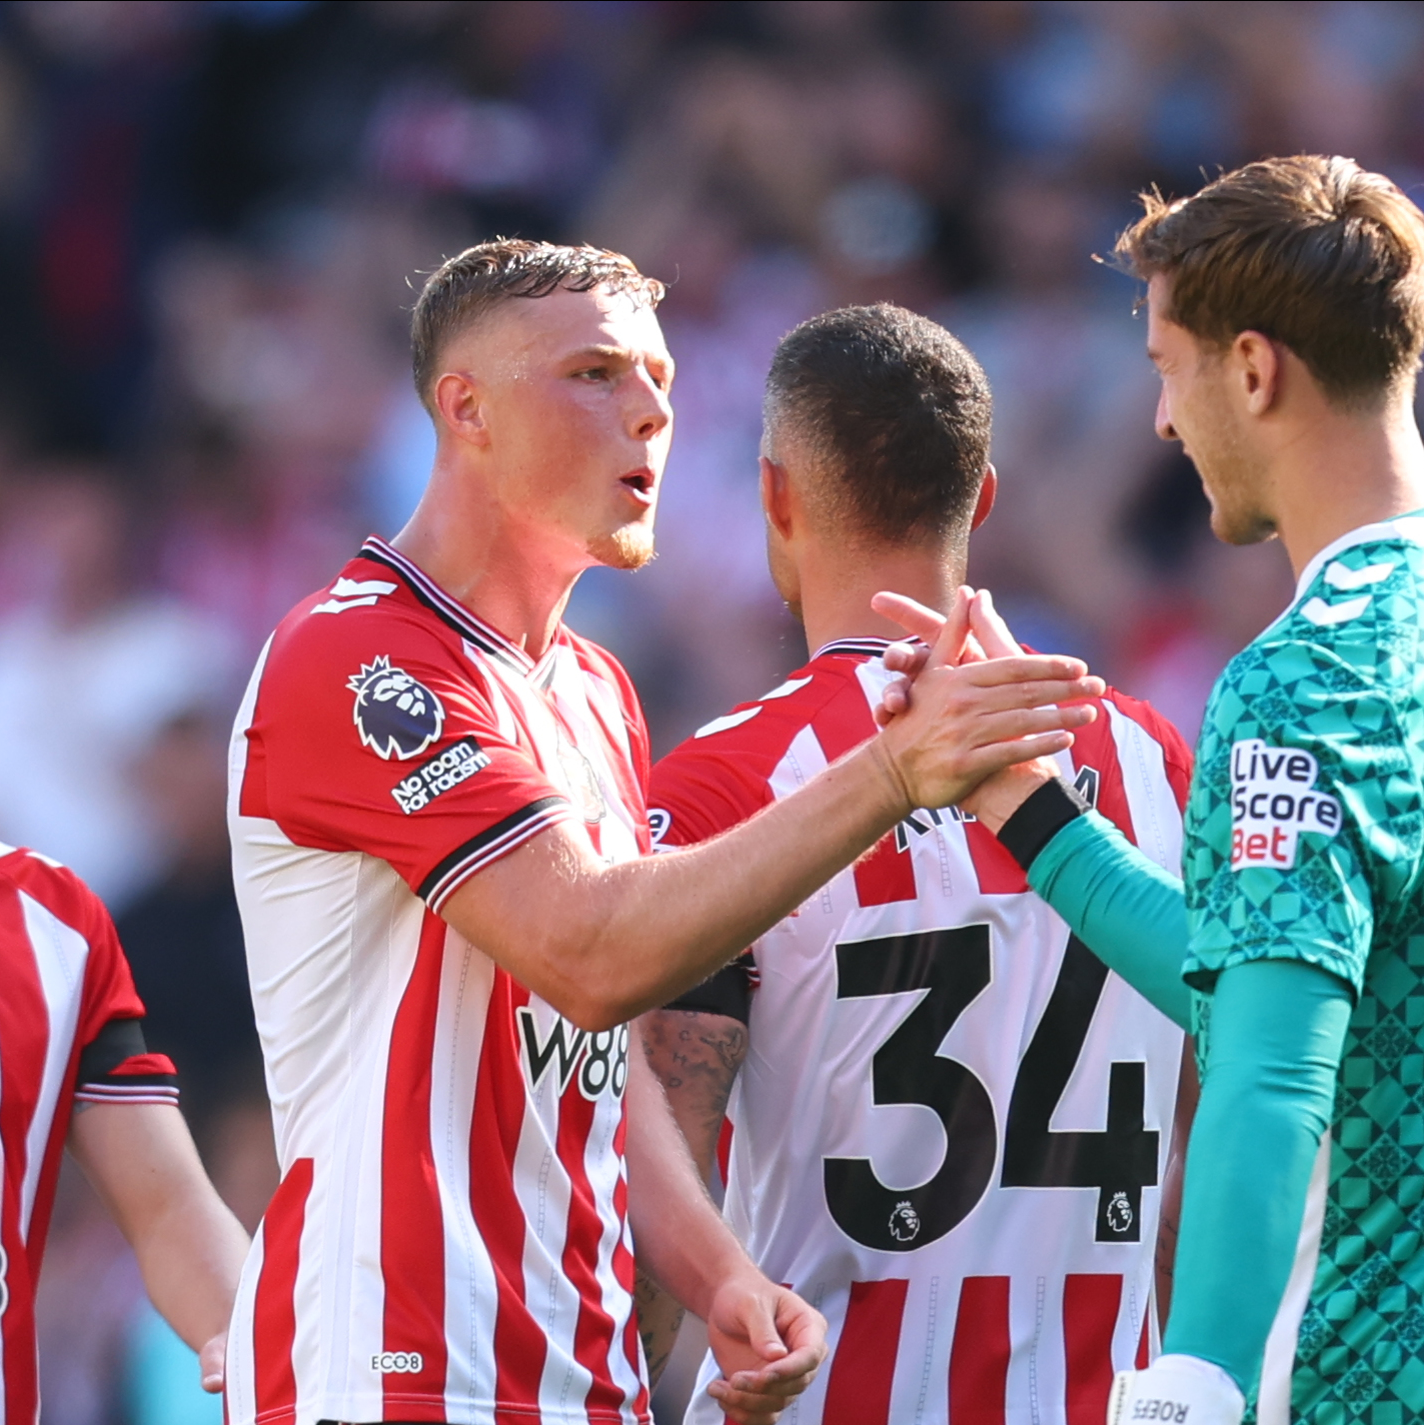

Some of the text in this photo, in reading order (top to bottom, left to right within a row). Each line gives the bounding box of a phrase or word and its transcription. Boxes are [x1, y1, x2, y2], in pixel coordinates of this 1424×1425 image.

[391, 742, 474, 806] No room
[401, 751, 492, 815] for racism
[1235, 744, 1311, 782] Live
[1234, 786, 1338, 829] Score
[1231, 827, 1288, 863] Bet
[519, 1010, 629, 1099] W88
[821, 922, 1161, 1254] 34
[372, 1355, 420, 1370] ECO8
